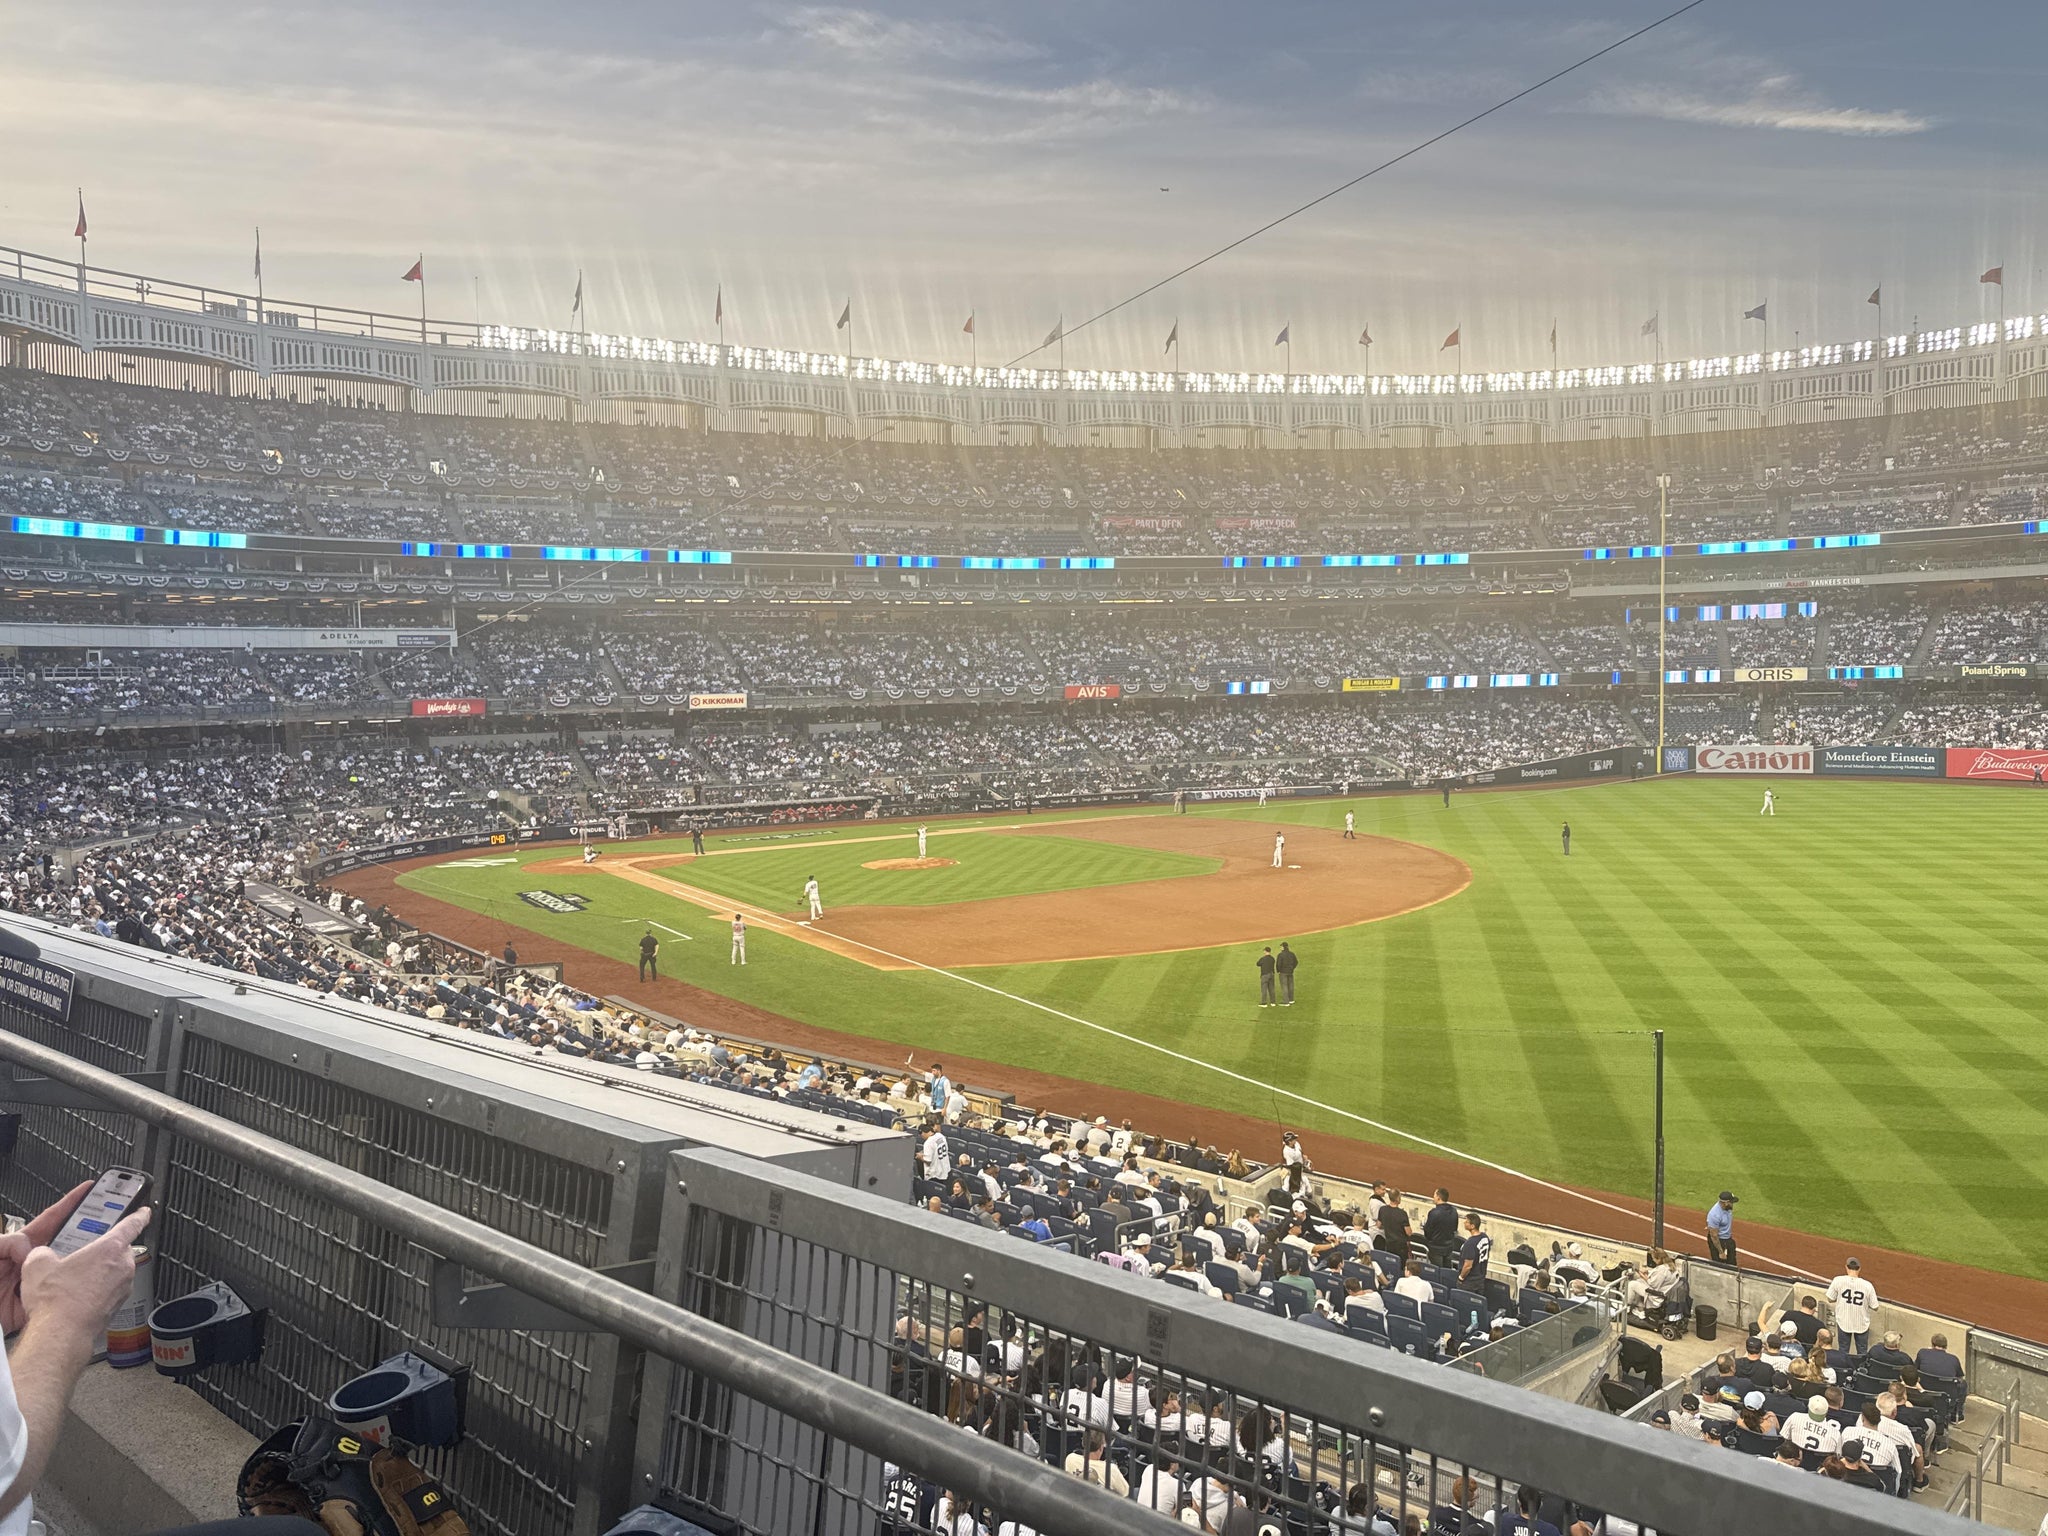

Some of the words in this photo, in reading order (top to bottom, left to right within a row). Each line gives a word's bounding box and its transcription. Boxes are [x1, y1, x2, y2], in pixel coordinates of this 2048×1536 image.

[1135, 519, 1159, 528] PARTY
[1161, 519, 1183, 528] DECK
[1250, 519, 1274, 528] PARTY
[1275, 519, 1296, 528] DECK
[1810, 578, 1841, 586] YANKEES
[1748, 668, 1793, 680] ORIS
[1962, 666, 1993, 676] Poland
[1994, 665, 2028, 676] Spring
[1077, 686, 1108, 698] AVIS
[427, 701, 457, 714] Wendy's
[1698, 748, 1810, 770] Canon
[1826, 752, 1888, 762] Montefiore
[1890, 752, 1936, 763] Einstein
[1602, 760, 1614, 770] APP
[1521, 768, 1558, 778] Booking.com
[490, 835, 506, 844] 048
[394, 847, 412, 855] GEICO
[342, 858, 355, 866] GEICO
[4, 956, 12, 970] DO
[12, 960, 23, 974] NOT
[22, 962, 35, 978] LEAN
[44, 970, 60, 988] REACH
[6, 978, 14, 992] OR
[14, 980, 29, 998] STAND
[29, 986, 42, 1002] NEAR
[1116, 1137, 1124, 1148] 2
[1841, 1288, 1864, 1306] 42
[1068, 1403, 1080, 1428] 2
[1193, 1424, 1215, 1439] JETR
[1803, 1421, 1828, 1438] JETER
[1804, 1436, 1820, 1450] 2
[886, 1492, 916, 1521] 25
[1514, 1526, 1540, 1536] JUDE
